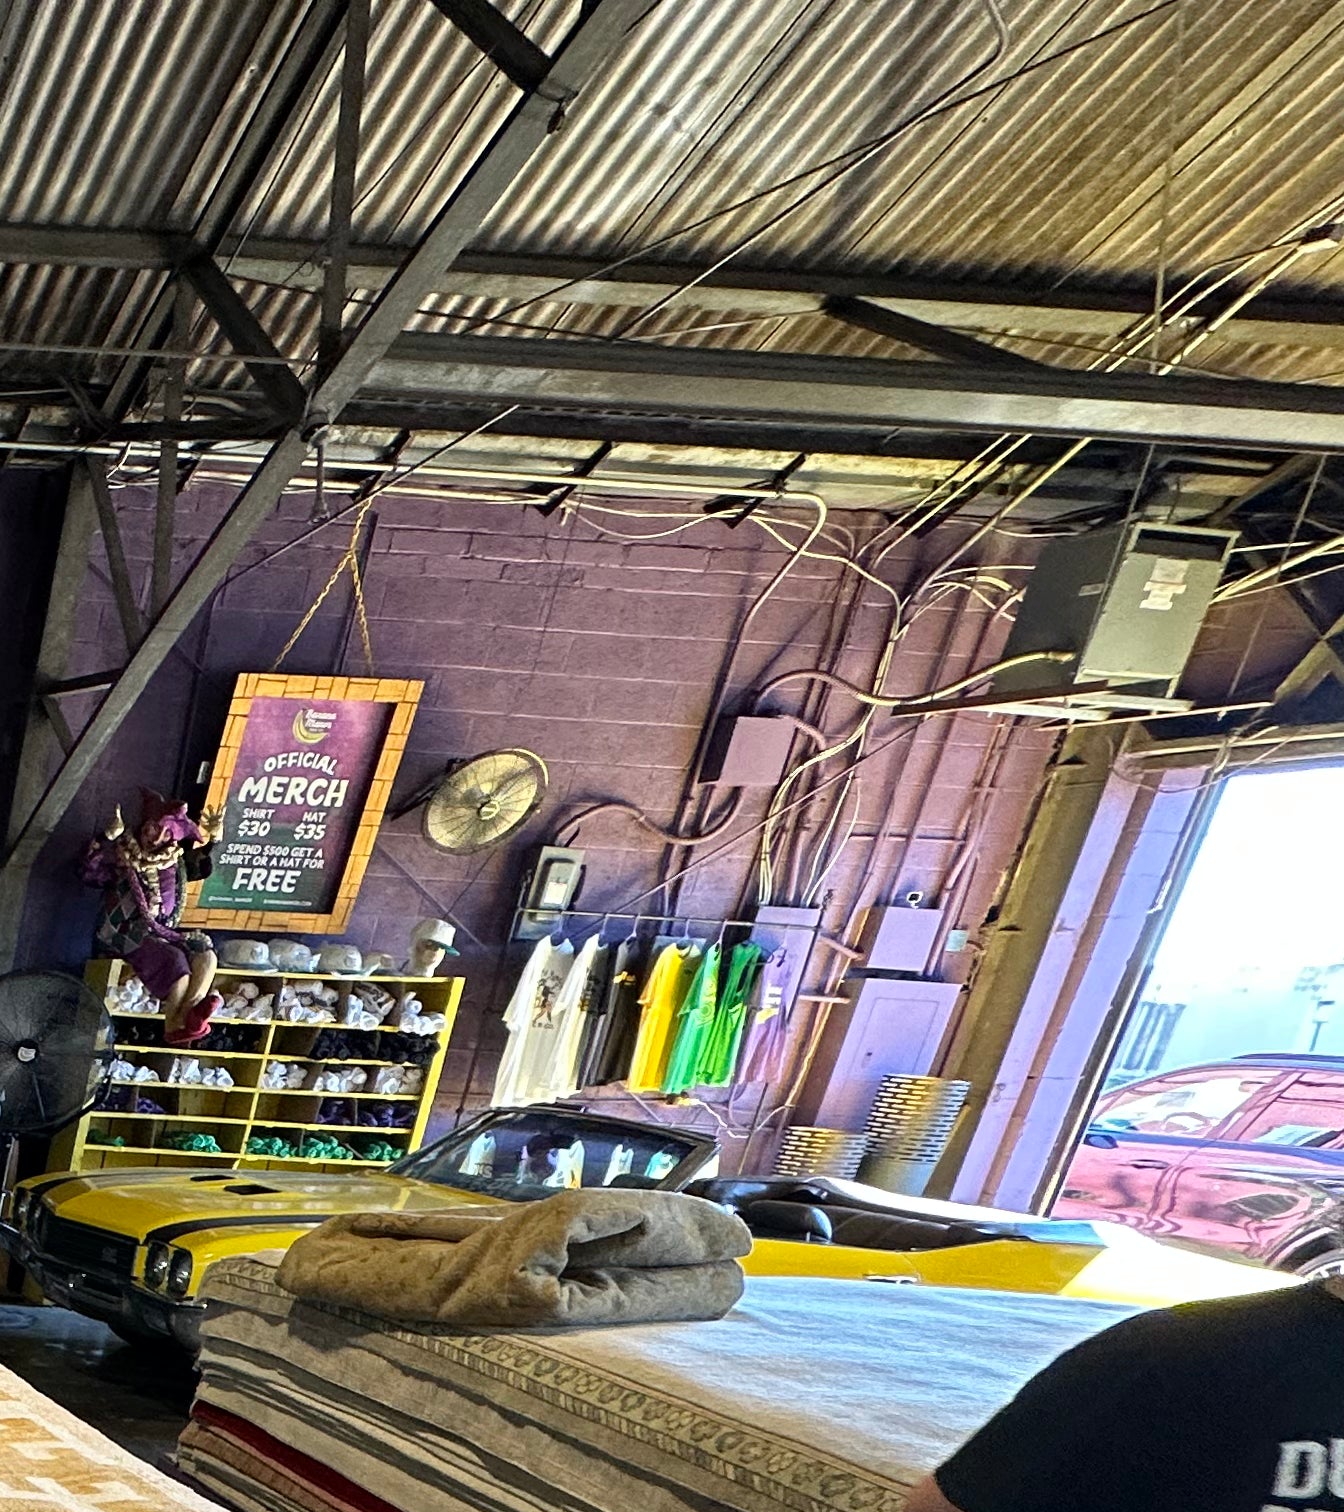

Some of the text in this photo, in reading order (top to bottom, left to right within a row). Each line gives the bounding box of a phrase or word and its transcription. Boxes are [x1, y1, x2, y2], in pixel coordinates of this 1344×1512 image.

[264, 751, 338, 775] OFFICIAL
[238, 776, 350, 808] MERCH
[242, 808, 275, 819] SHIRT
[302, 811, 326, 823] HAT
[238, 820, 271, 837] $30
[293, 823, 327, 841] $35
[226, 843, 323, 858] SPEND $500 GET A
[219, 854, 325, 869] SHIRT OR A HAT FOR
[232, 867, 301, 894] FREE
